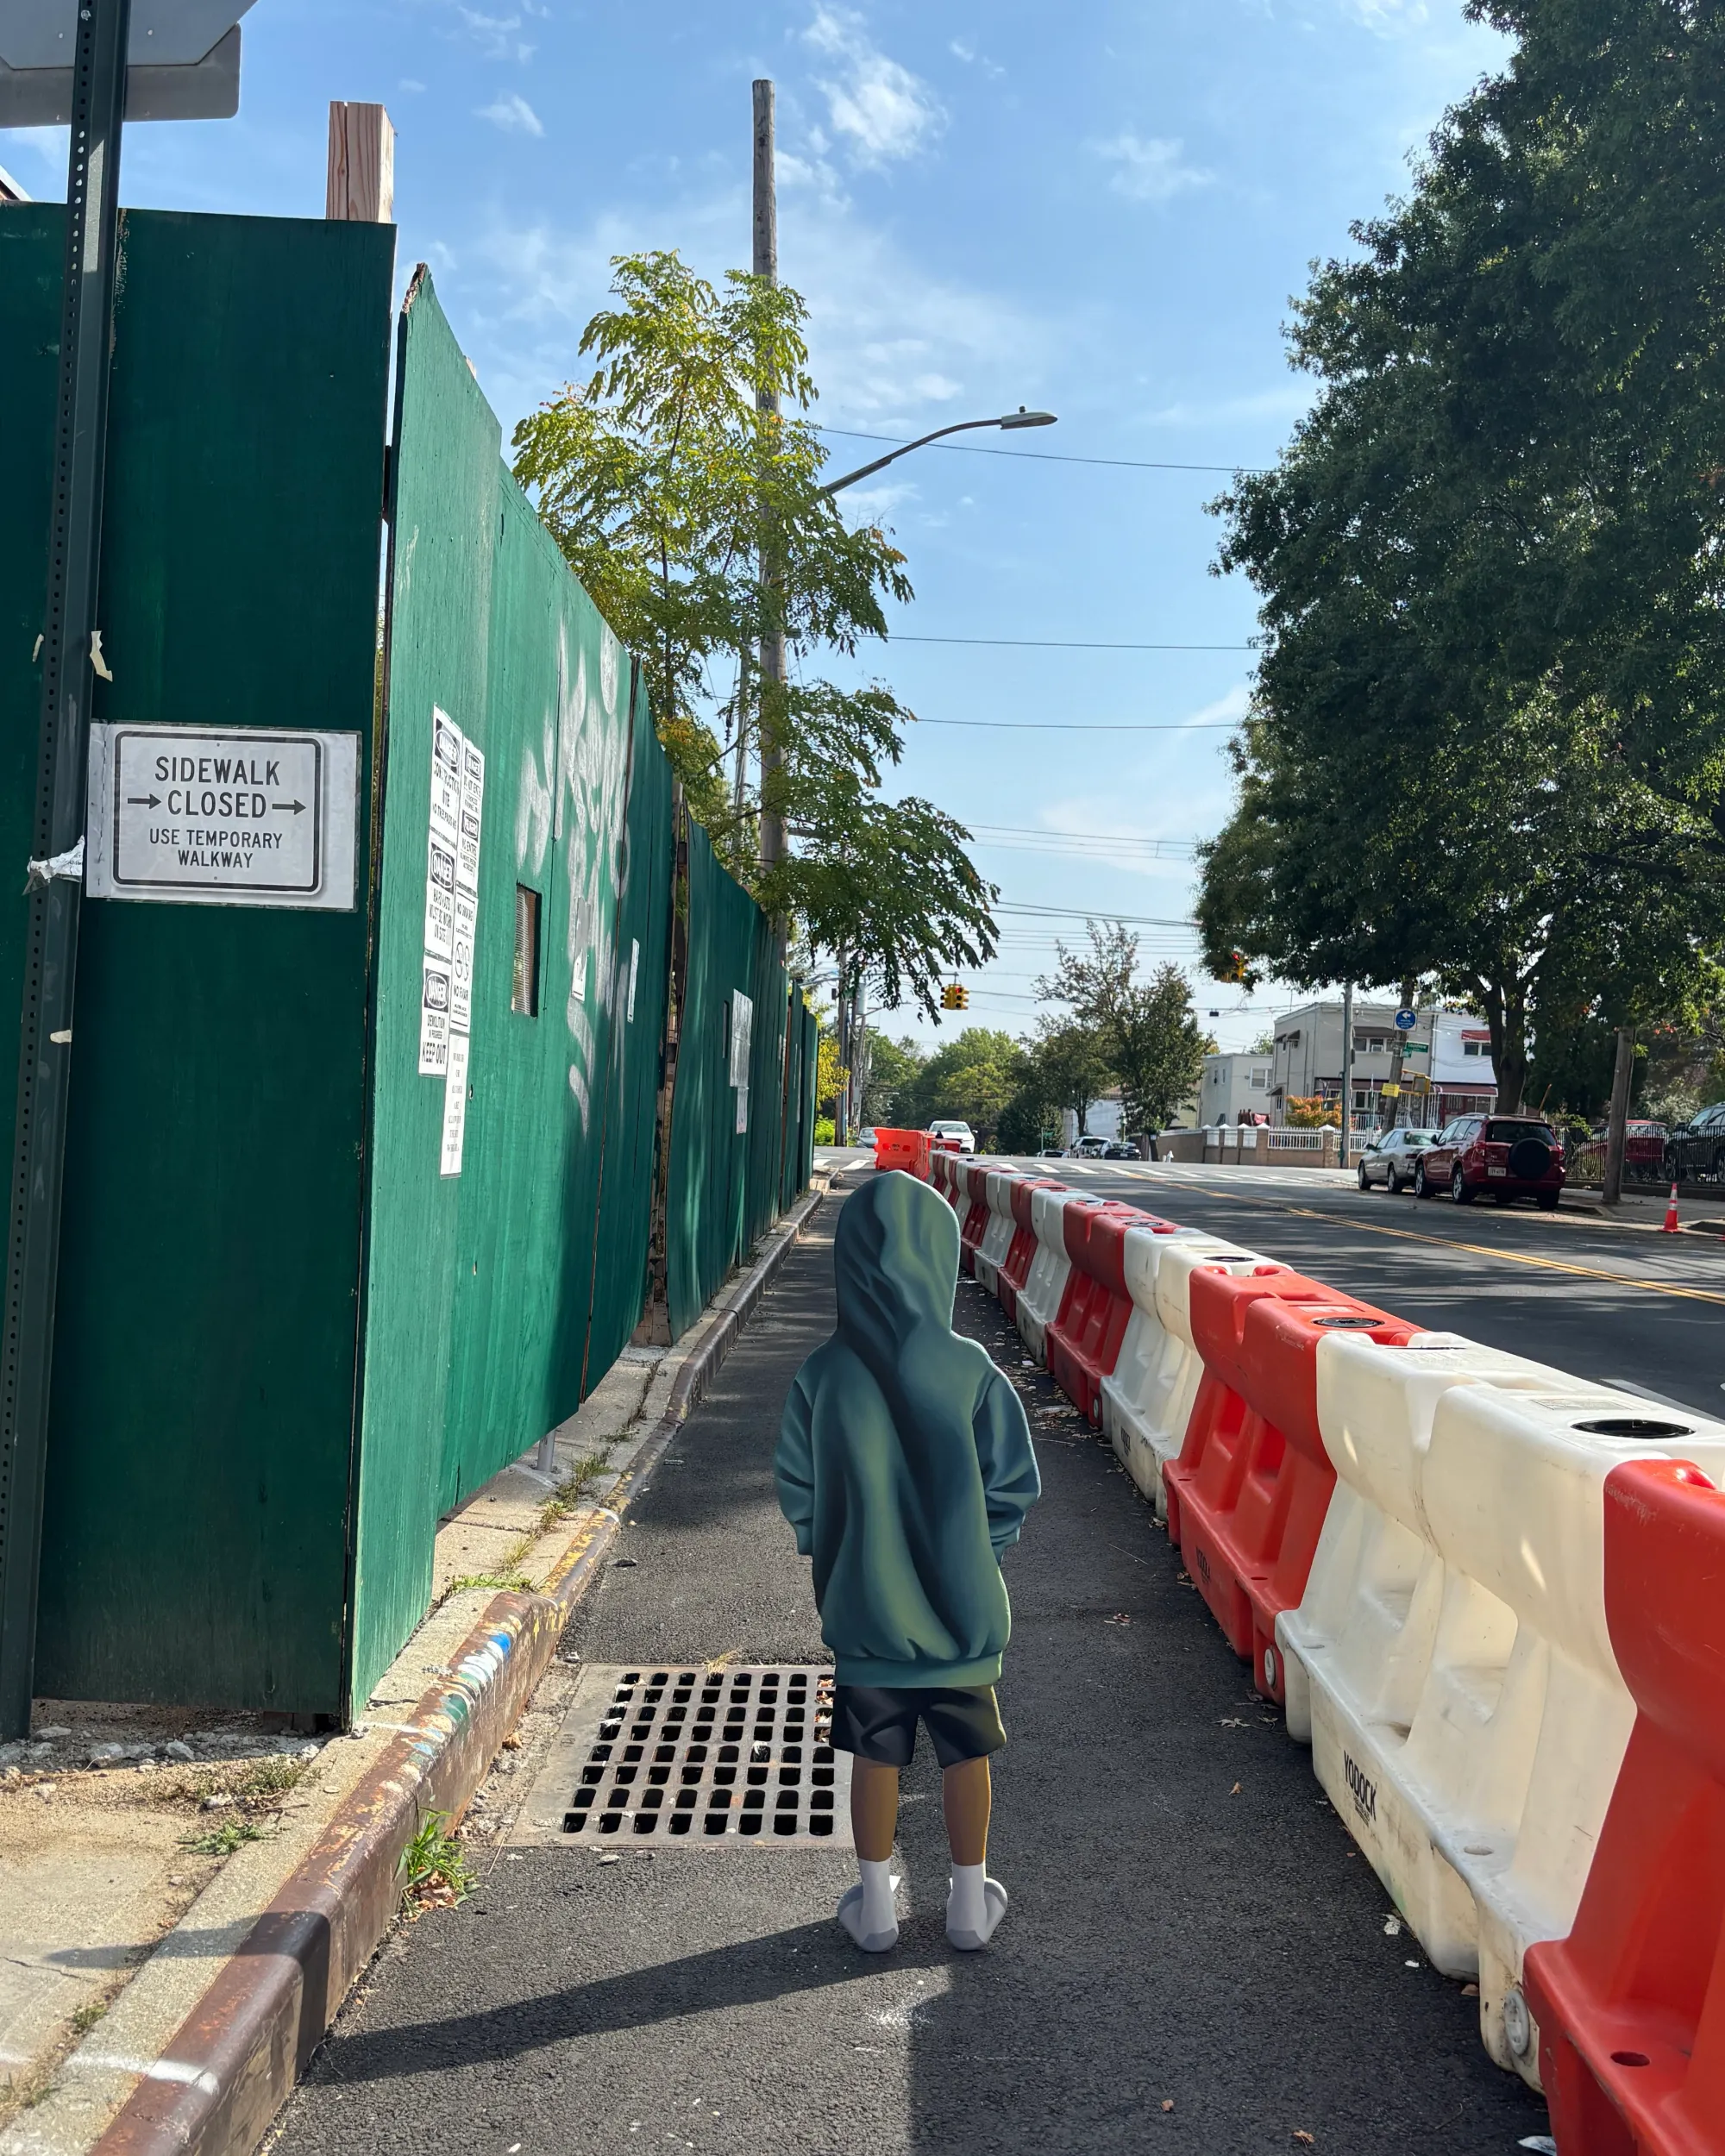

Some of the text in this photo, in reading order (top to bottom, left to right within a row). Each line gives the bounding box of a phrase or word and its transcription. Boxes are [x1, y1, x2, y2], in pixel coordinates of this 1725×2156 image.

[154, 755, 280, 786] SIDEWALK
[167, 789, 267, 818] CLOSED
[149, 828, 283, 849] USE TEMPORARY
[177, 849, 254, 868] WALKWAY
[422, 1041, 436, 1063] KEEP
[436, 1044, 447, 1065] OUT
[1344, 1750, 1377, 1822] YODOCK
